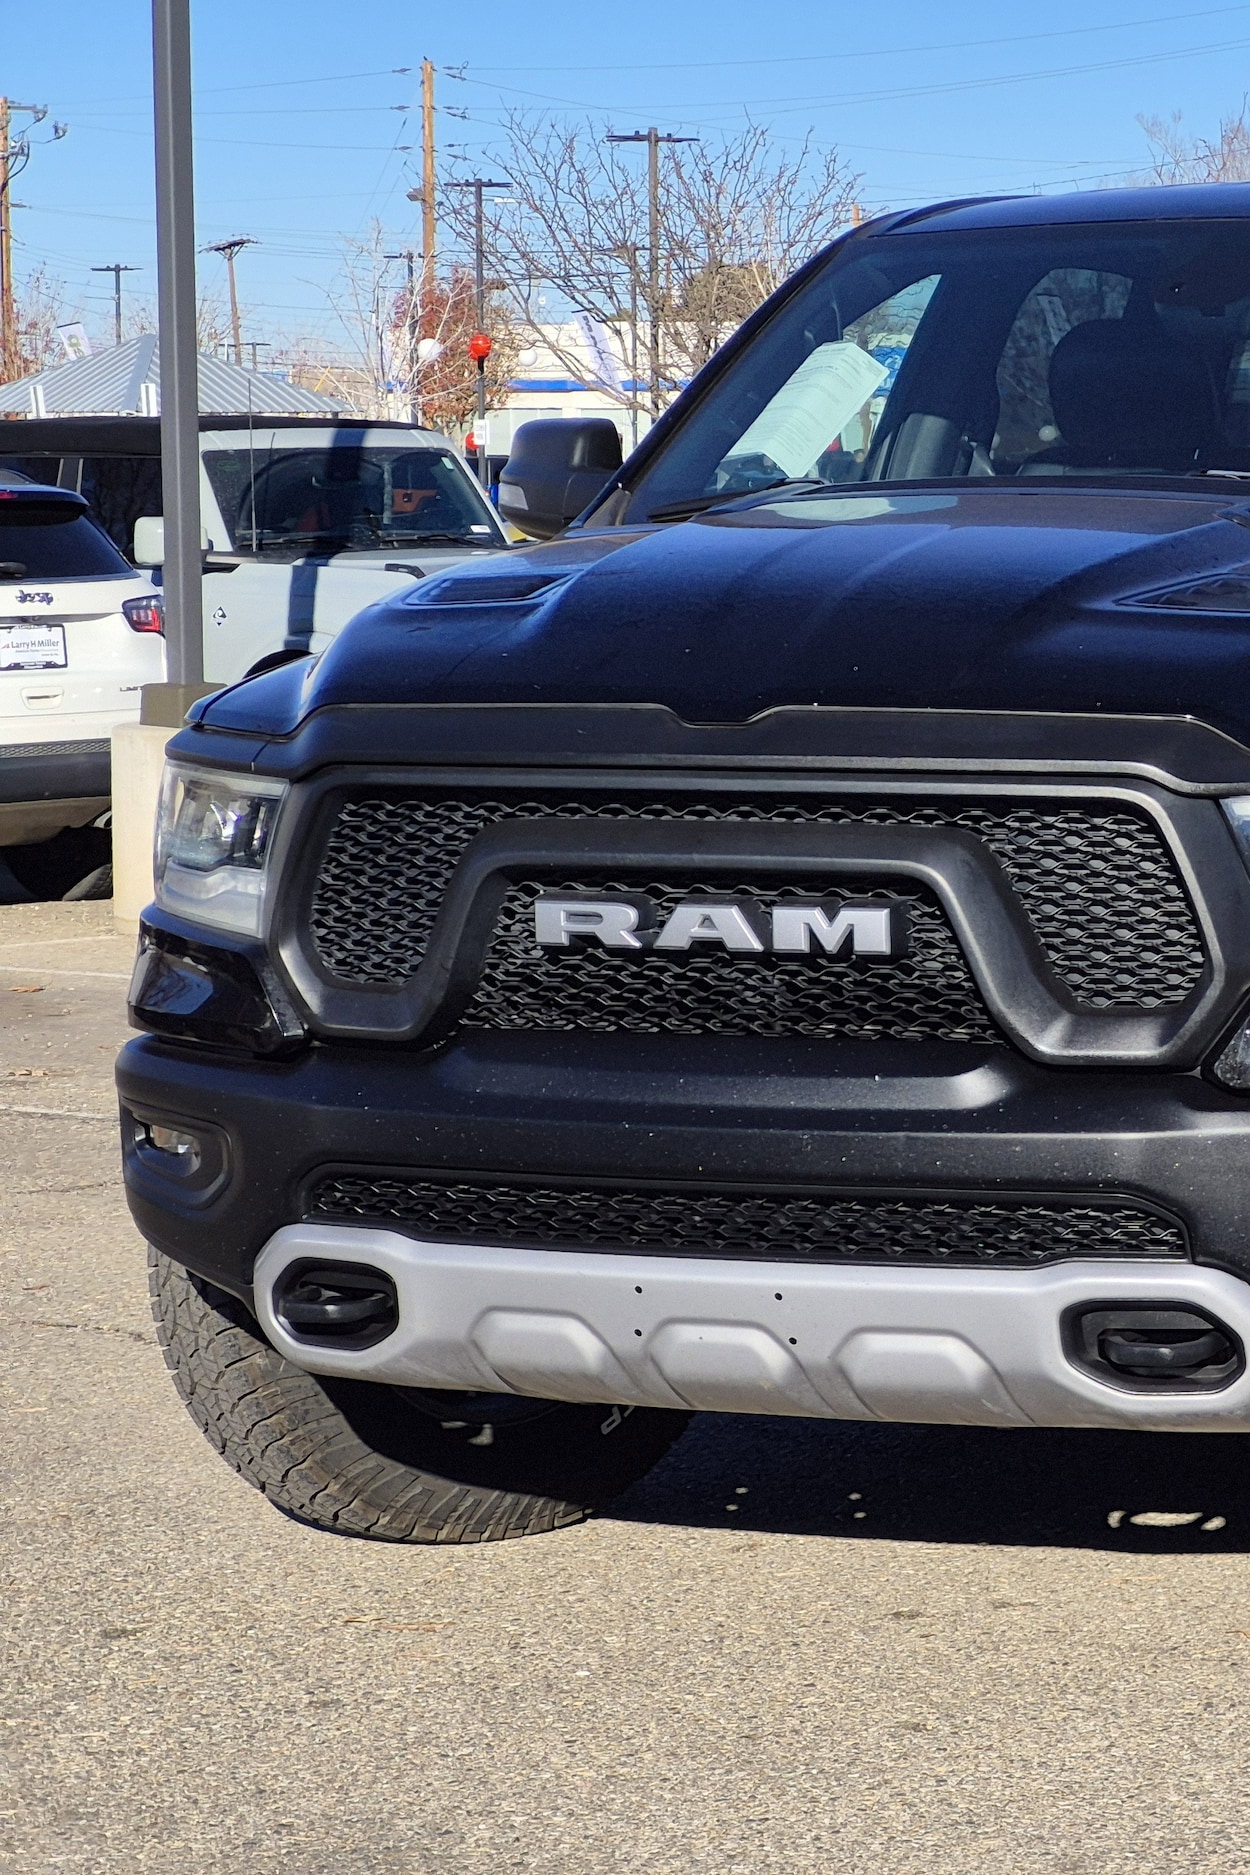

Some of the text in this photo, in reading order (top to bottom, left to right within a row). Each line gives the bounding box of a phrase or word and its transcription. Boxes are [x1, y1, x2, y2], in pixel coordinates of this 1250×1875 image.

[11, 641, 30, 649] Larry
[37, 639, 60, 648] Miller
[535, 900, 892, 955] RAM
